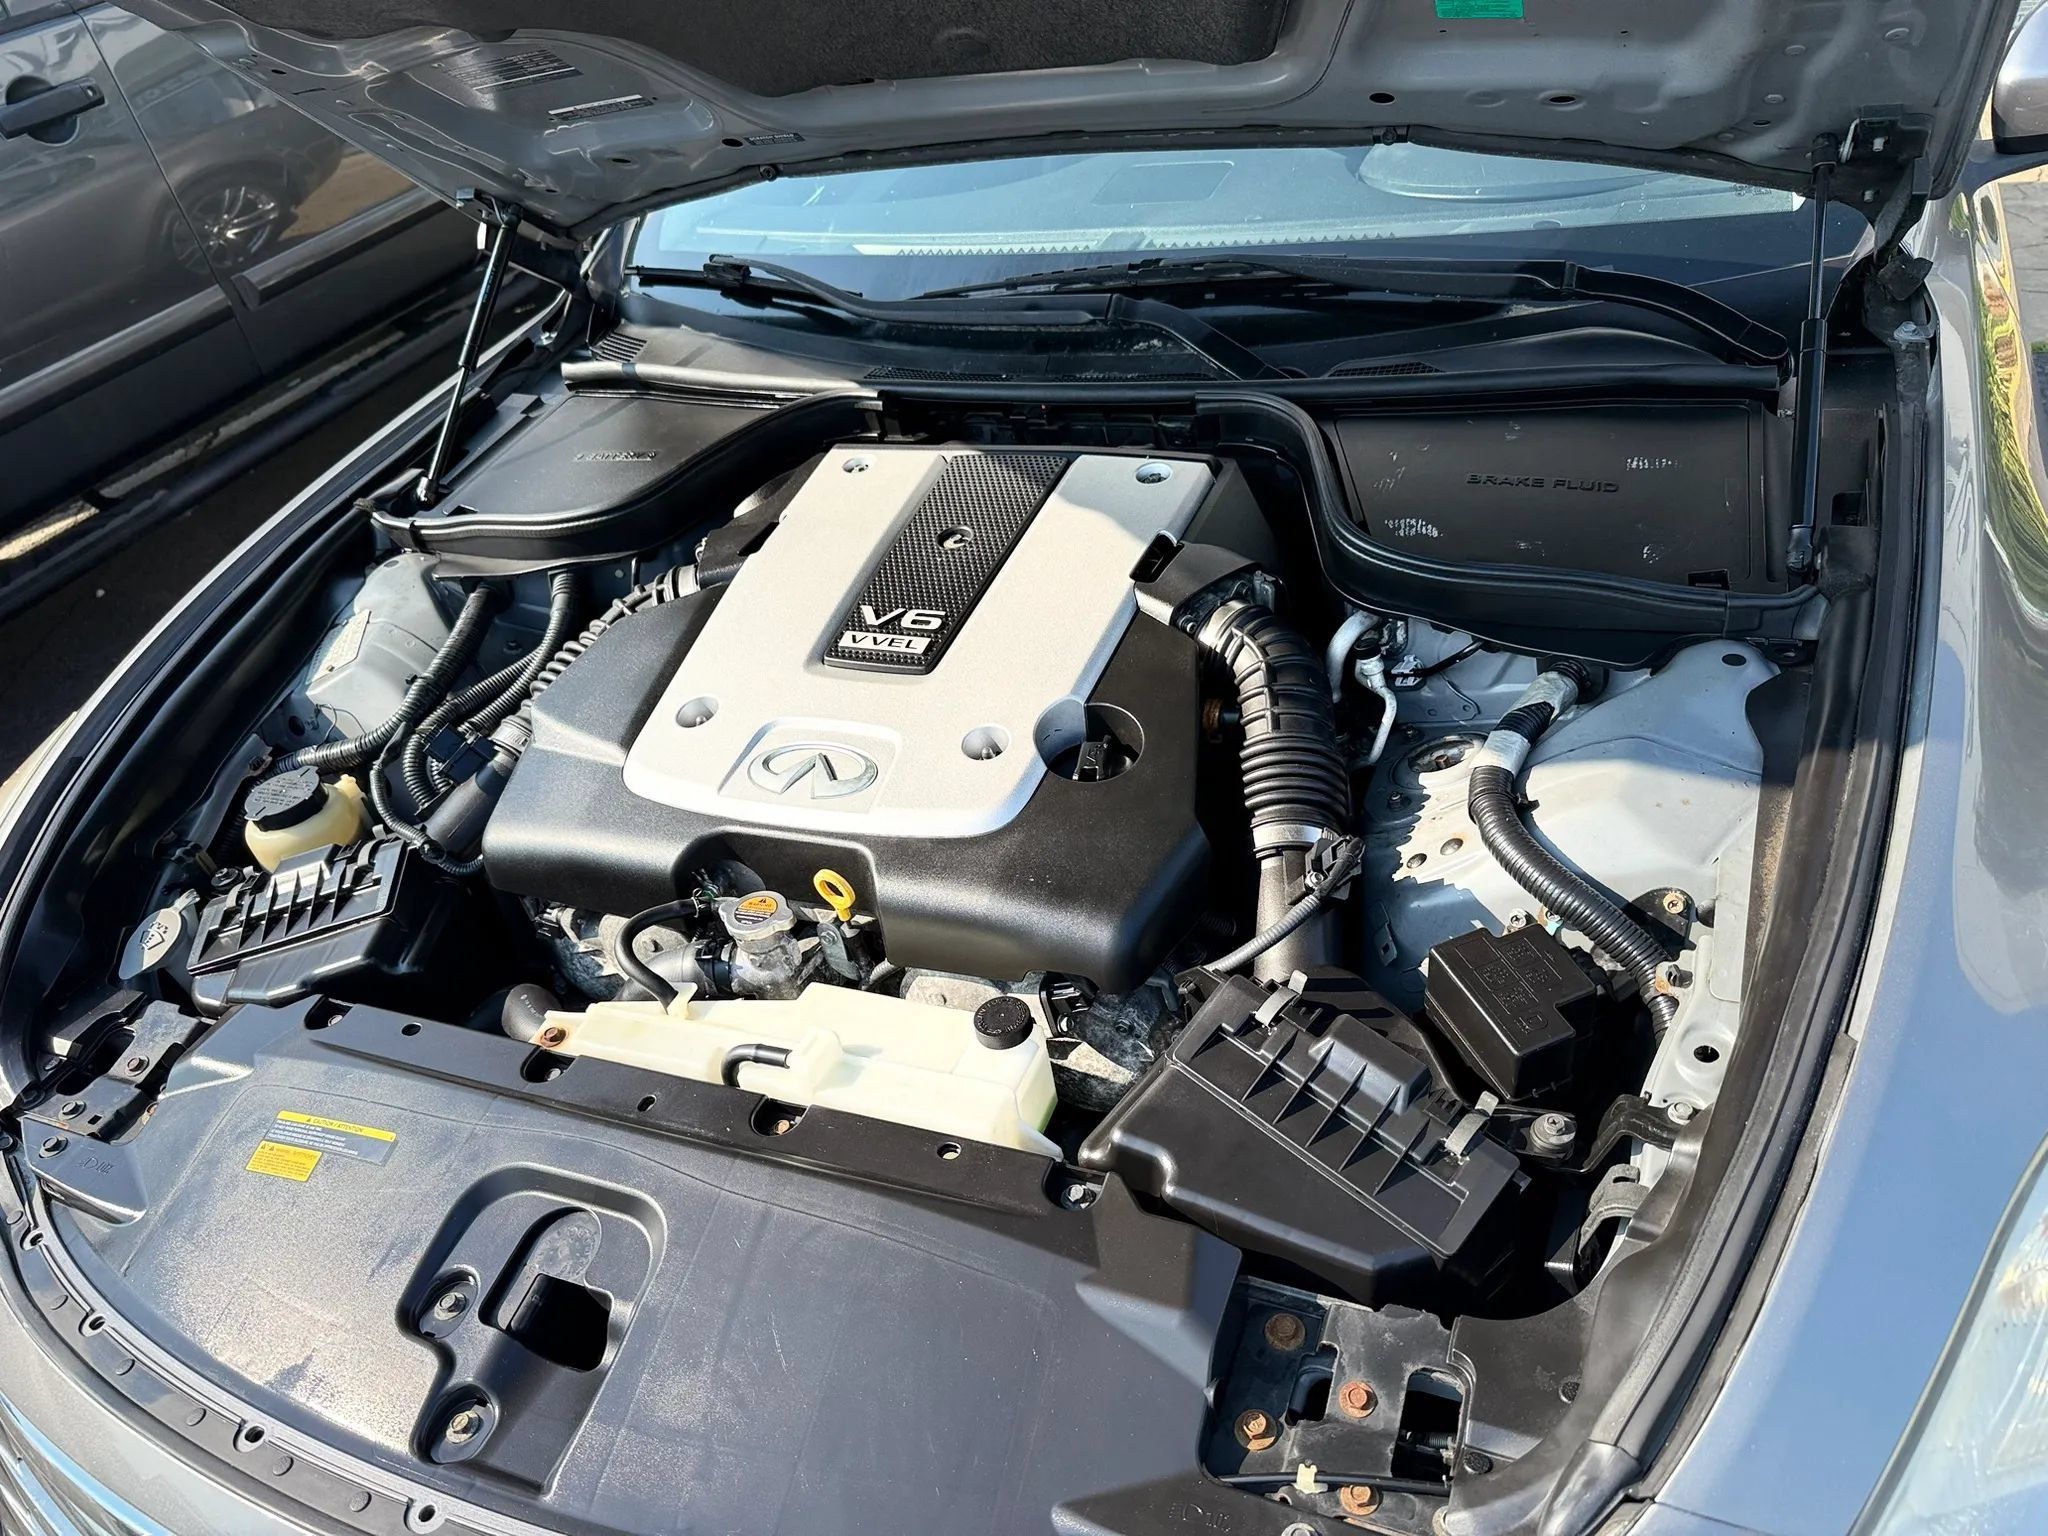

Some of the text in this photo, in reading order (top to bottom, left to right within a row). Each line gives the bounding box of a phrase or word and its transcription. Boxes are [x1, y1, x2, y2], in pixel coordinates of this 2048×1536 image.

[1466, 473, 1620, 493] BRAKE FLUID
[860, 604, 947, 630] V6
[851, 634, 918, 650] VVEL
